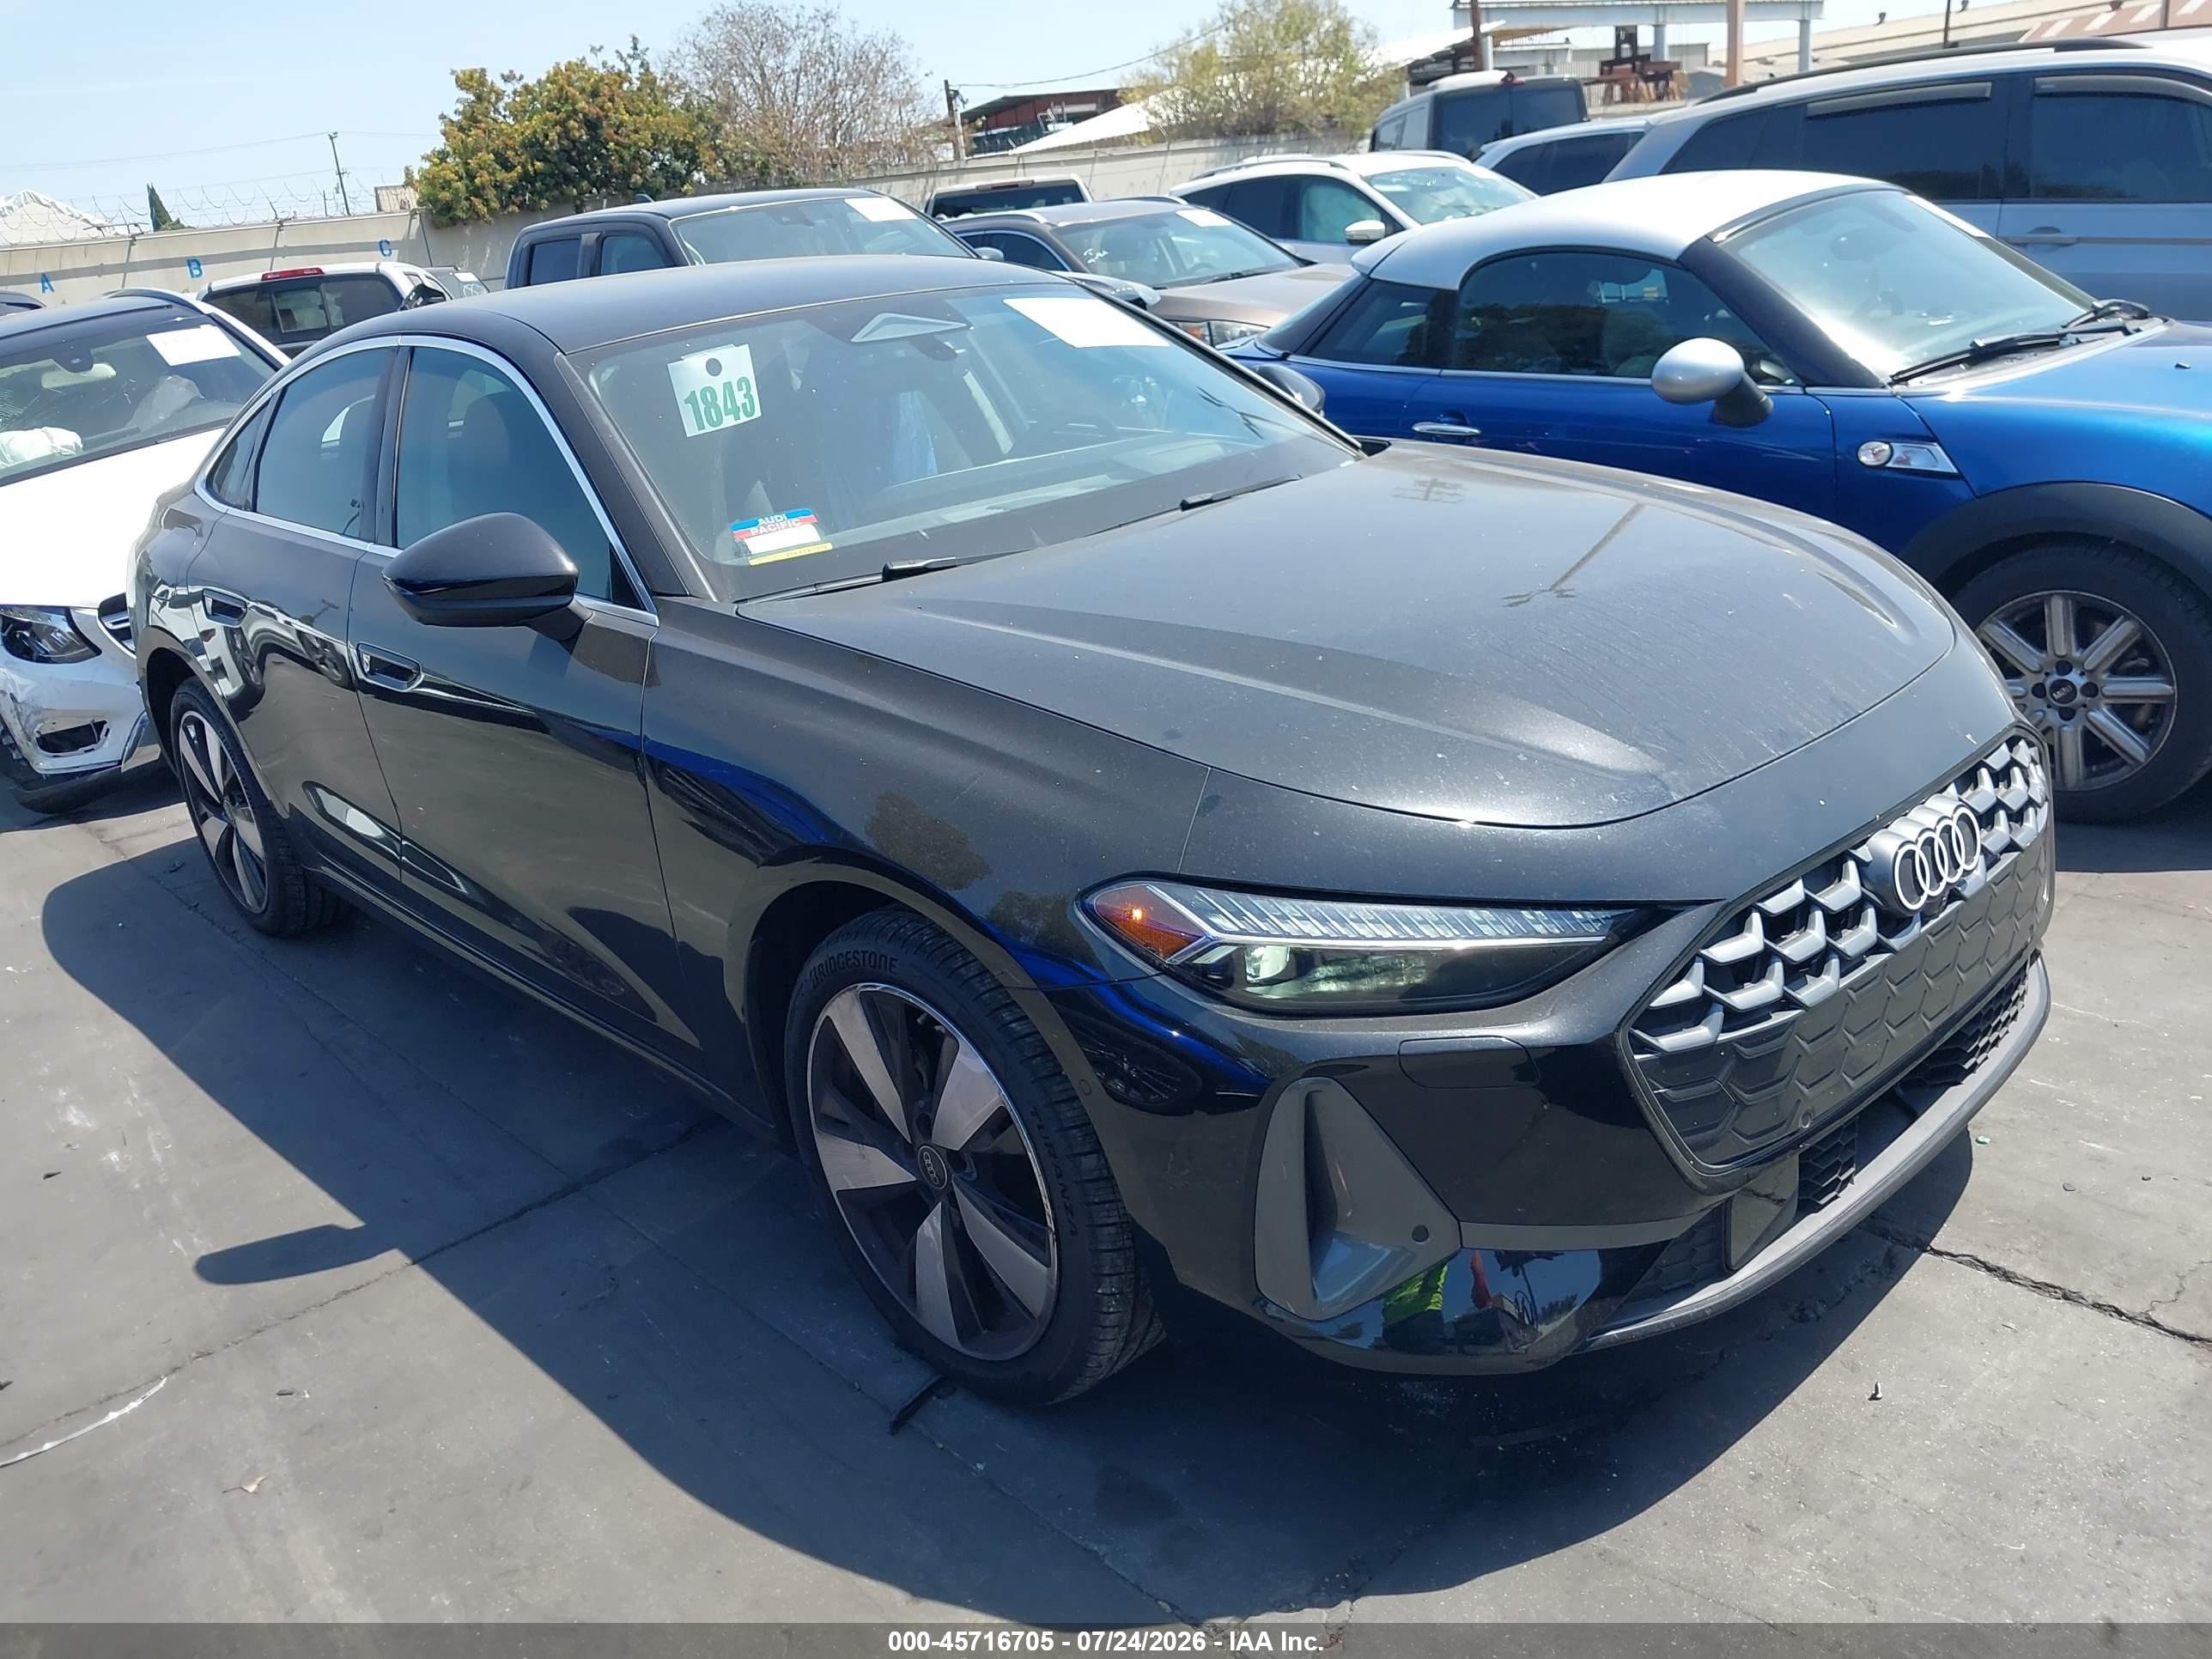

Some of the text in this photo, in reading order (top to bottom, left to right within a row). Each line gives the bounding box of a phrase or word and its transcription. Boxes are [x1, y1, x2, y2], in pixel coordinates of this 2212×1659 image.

[186, 258, 203, 279] B
[40, 271, 55, 294] A
[684, 376, 755, 431] 1843
[749, 519, 802, 536] PACIFIC
[757, 513, 787, 525] AUDI
[809, 950, 898, 989] BRIDGESTONE
[1030, 1105, 1079, 1237] TURANZA
